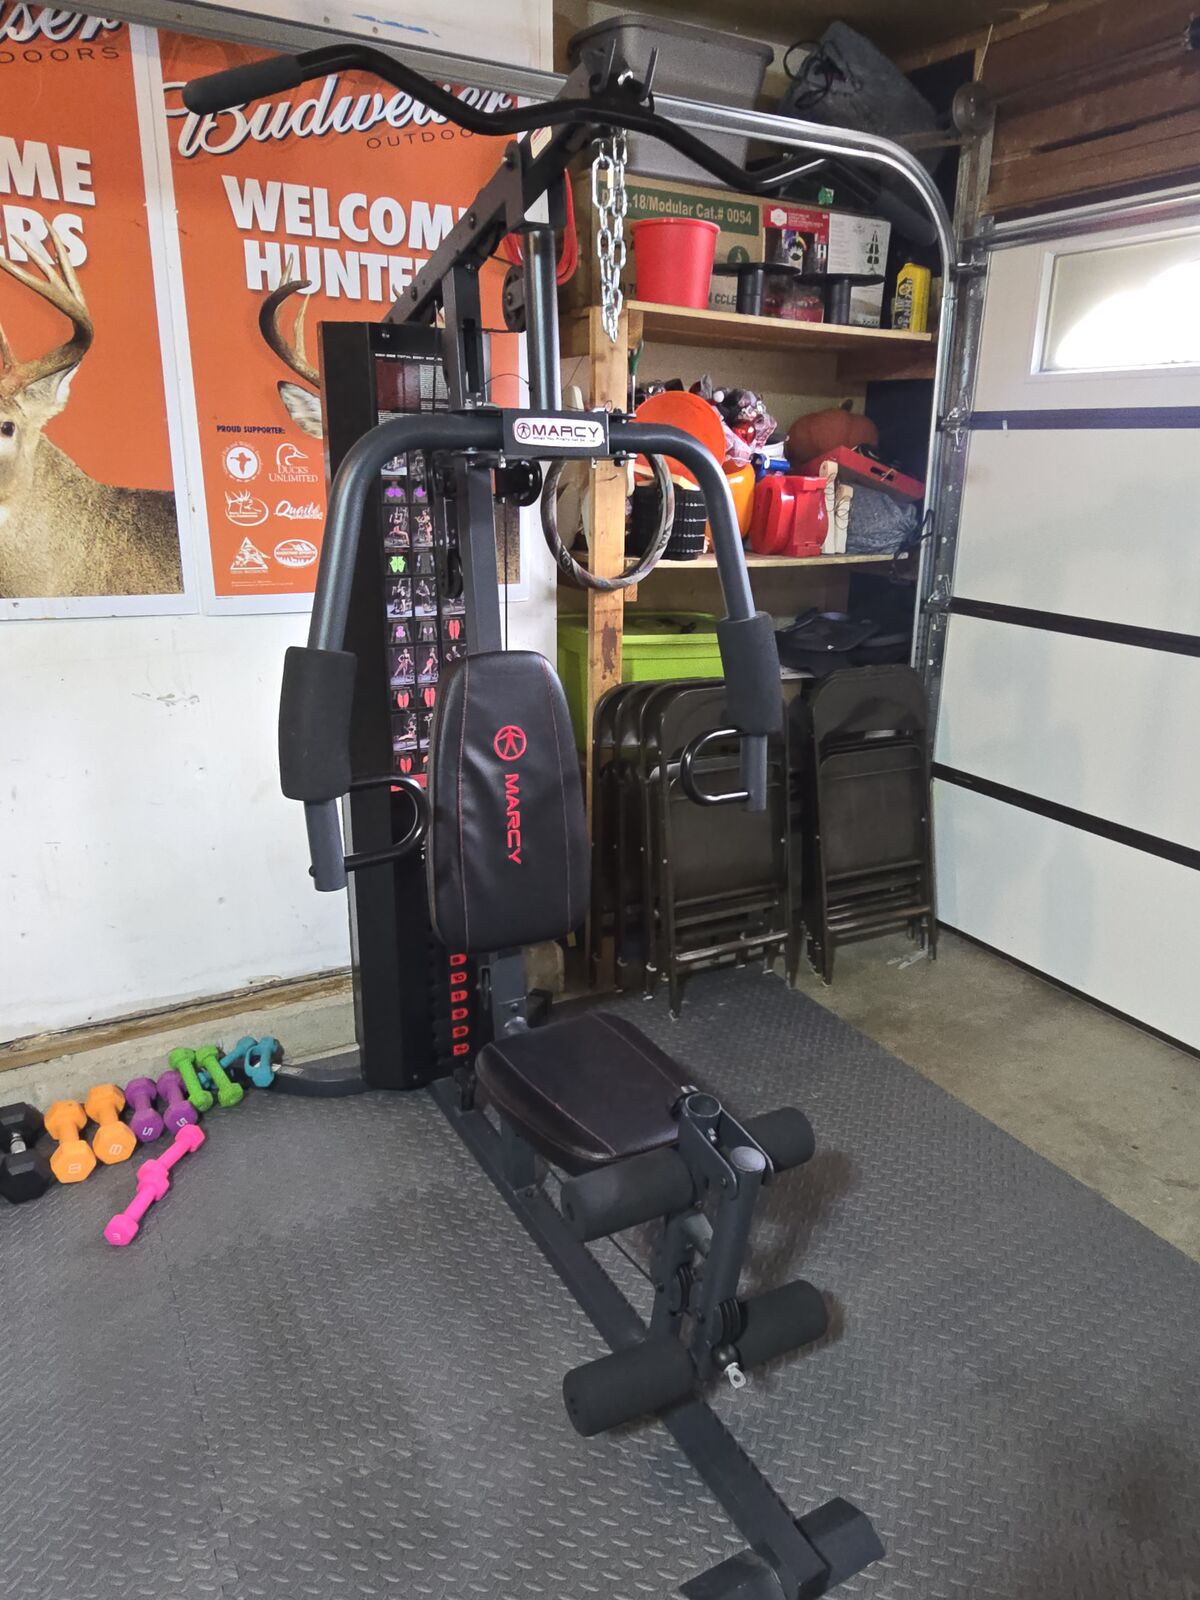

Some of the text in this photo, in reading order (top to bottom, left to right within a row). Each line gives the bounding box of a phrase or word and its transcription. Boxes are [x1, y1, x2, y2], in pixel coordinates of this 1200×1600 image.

[221, 174, 468, 251] WELCOM
[696, 203, 724, 221] Cat.#
[727, 208, 752, 225] 0054
[243, 239, 428, 302] HUNTE
[217, 425, 286, 435] PROUD SUPPORTER:
[532, 424, 599, 438] MARCY
[277, 464, 309, 475] DUCKS
[268, 473, 318, 483] UNLIMITED
[504, 773, 522, 865] MARCY
[176, 1117, 188, 1127] 5
[142, 1127, 153, 1136] 5
